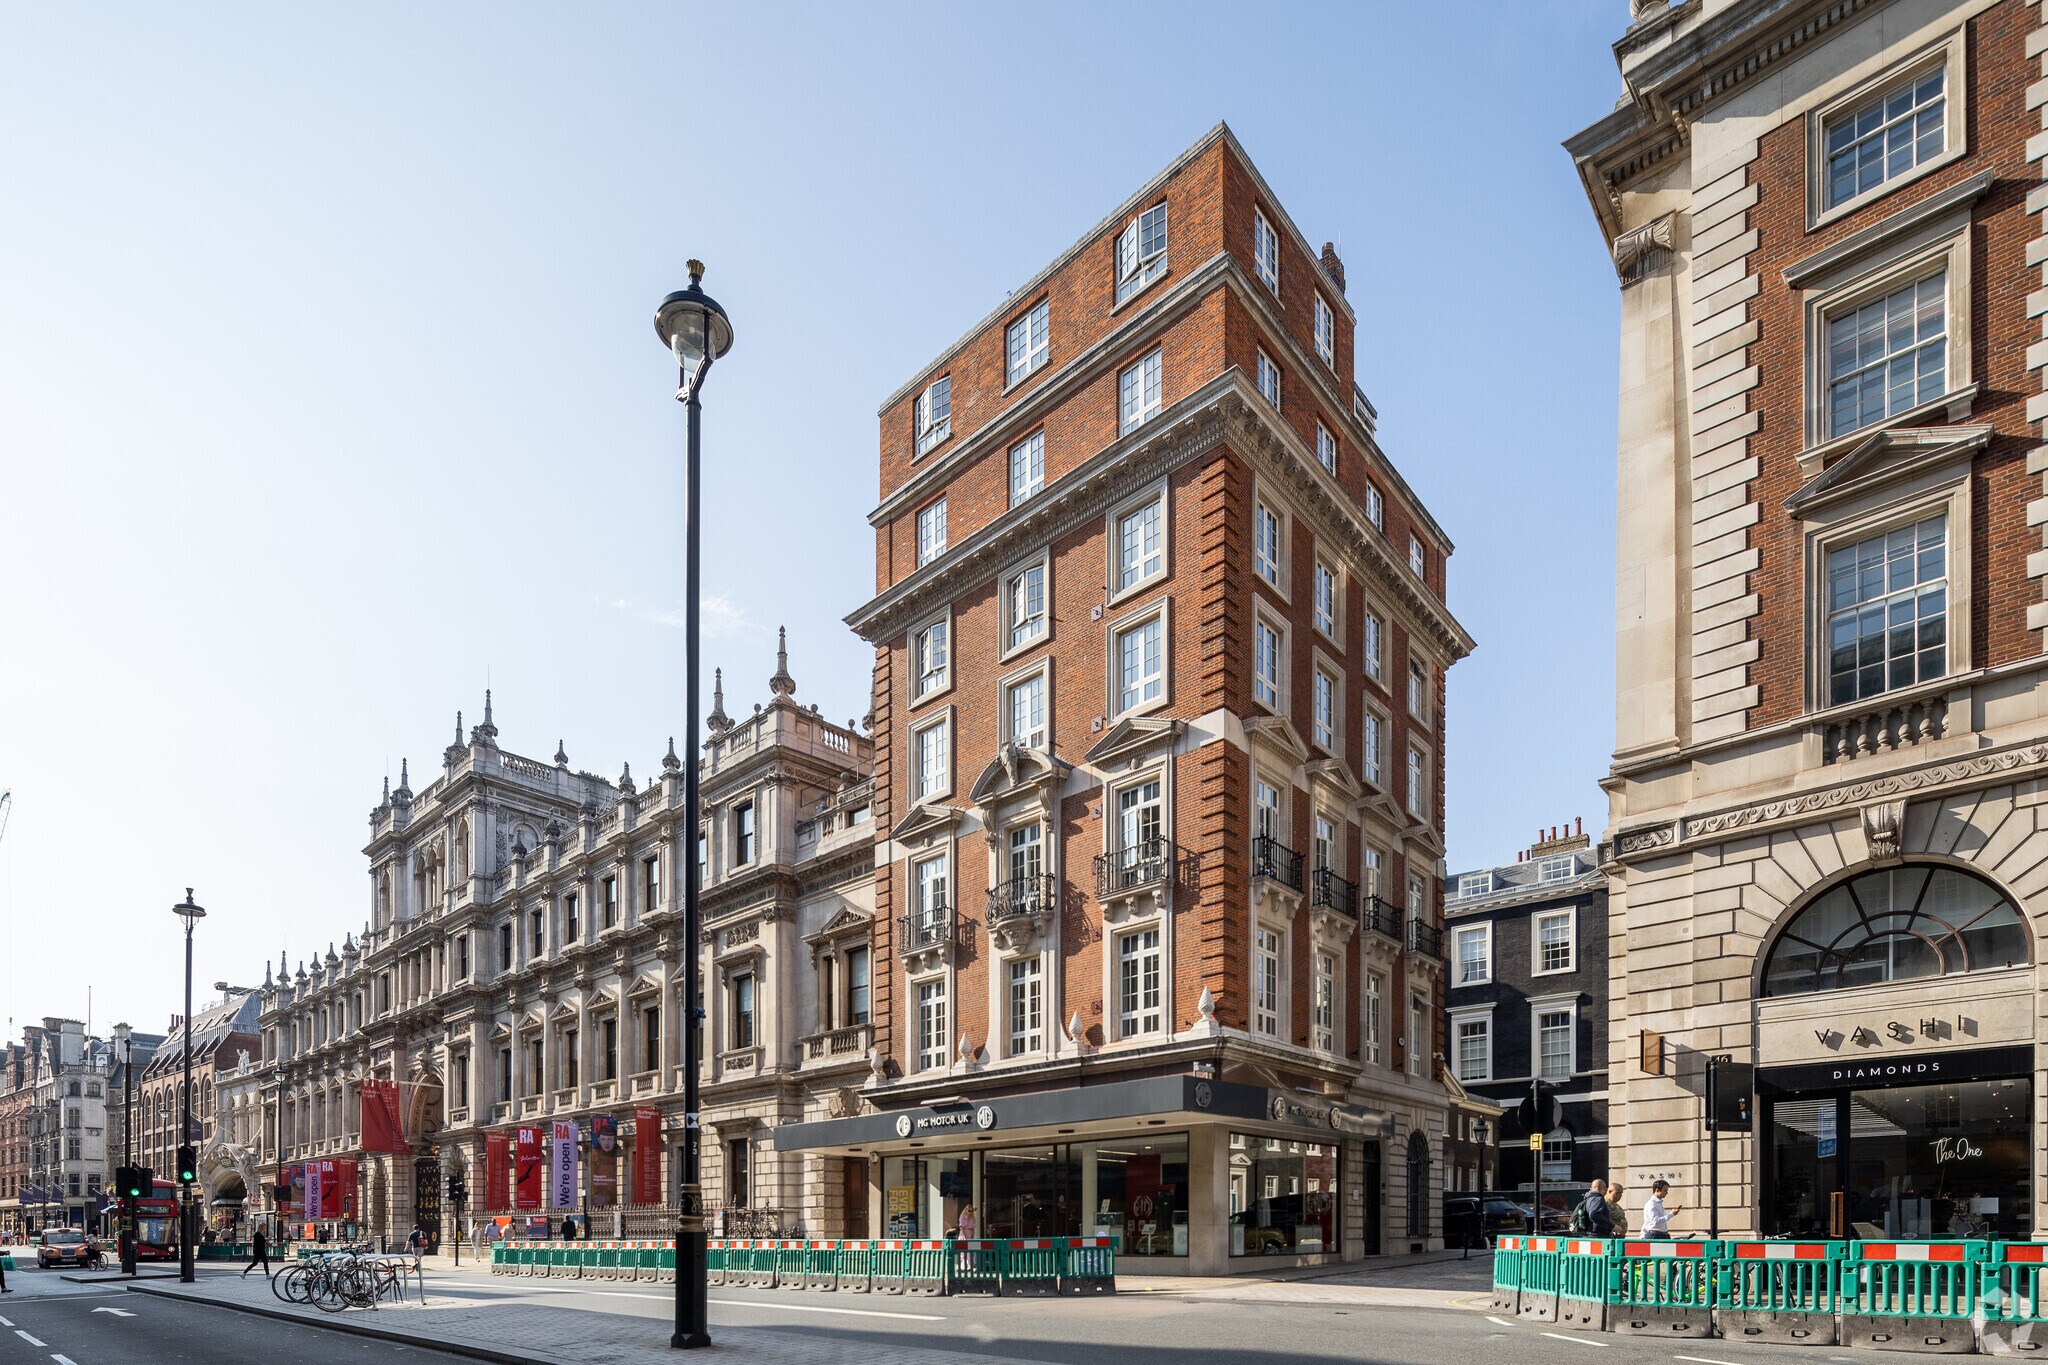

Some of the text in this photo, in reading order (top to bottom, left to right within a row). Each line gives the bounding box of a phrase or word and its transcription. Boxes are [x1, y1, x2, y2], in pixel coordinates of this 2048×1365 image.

[1815, 1014, 1961, 1045] VASHI
[1833, 1062, 1940, 1080] DIAMONDS
[917, 1113, 969, 1128] MG MOTOR UK
[978, 1107, 992, 1128] MG
[519, 1129, 534, 1144] RA
[555, 1124, 570, 1139] RA
[1929, 1137, 1983, 1164] The One
[306, 1164, 318, 1174] RA
[322, 1161, 334, 1172] RA
[559, 1142, 572, 1206] We're open
[311, 1176, 319, 1194] open
[889, 1190, 899, 1209] FOR
[898, 1190, 909, 1238] EVOLVED
